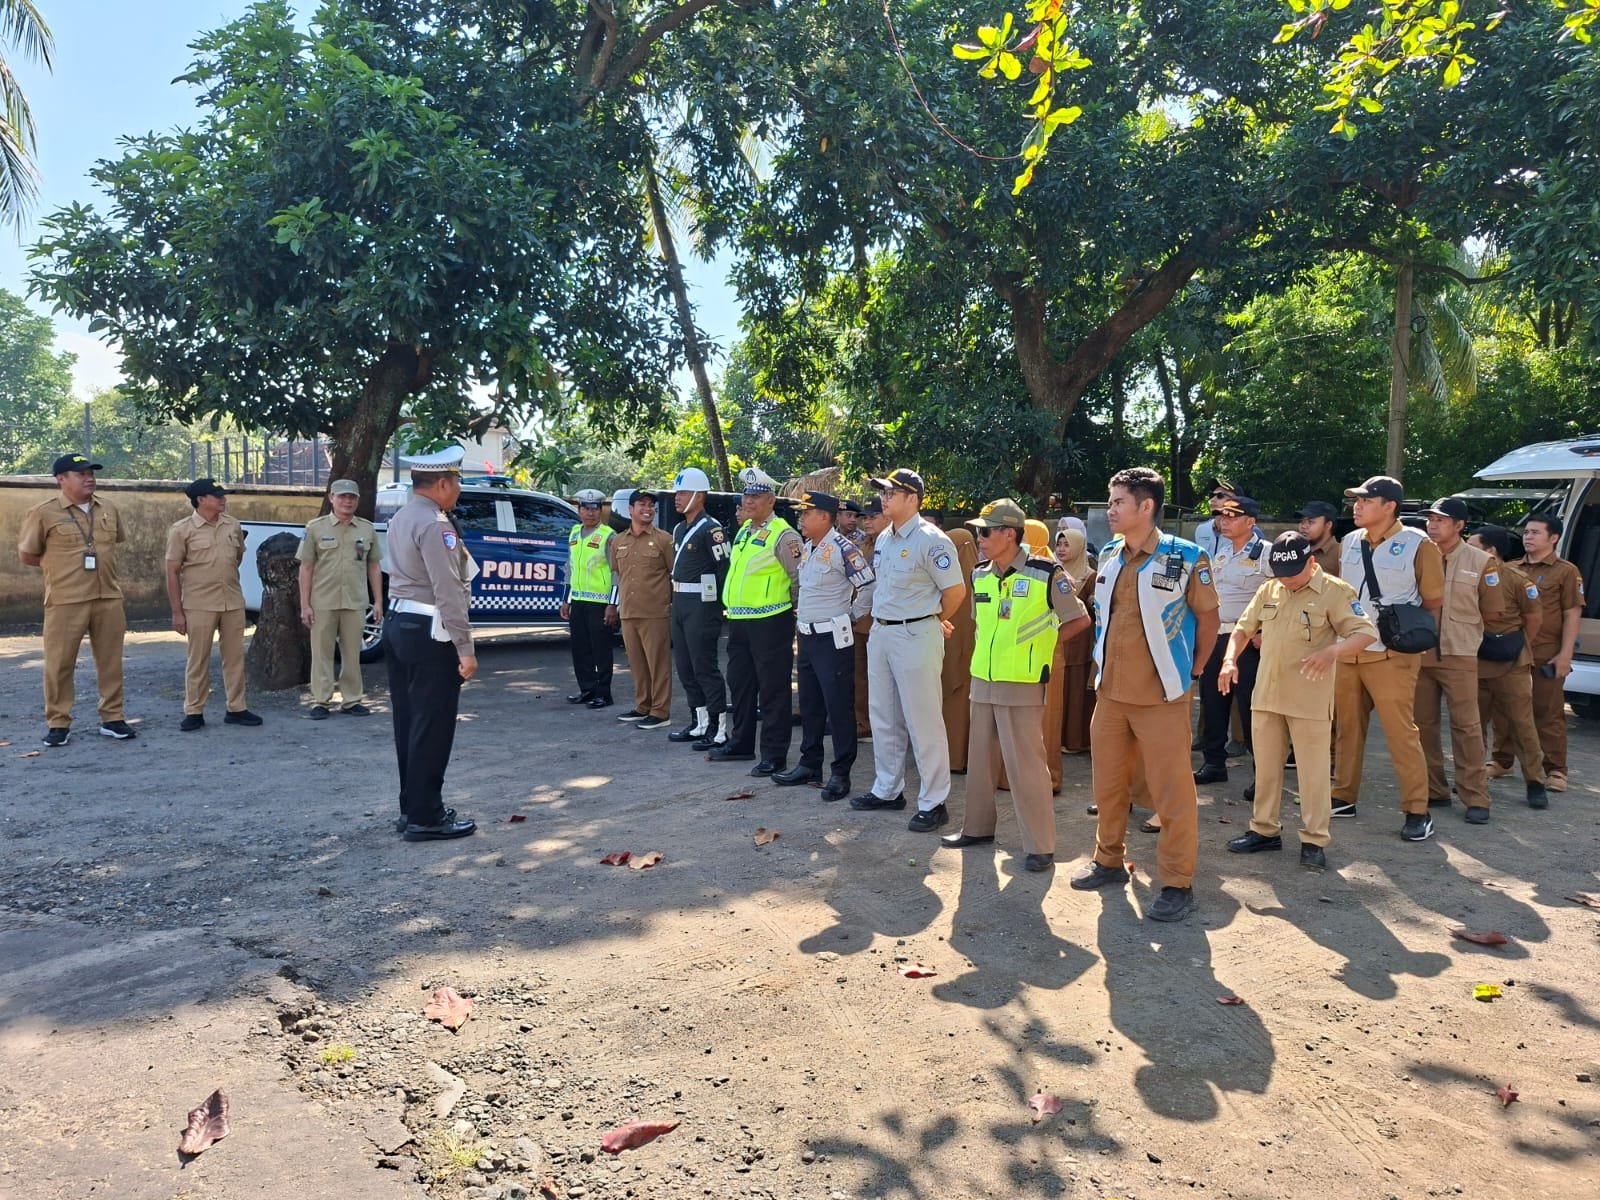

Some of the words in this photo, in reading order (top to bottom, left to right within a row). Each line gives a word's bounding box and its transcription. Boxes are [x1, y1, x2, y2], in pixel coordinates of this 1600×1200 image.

[482, 560, 556, 580] POLISI
[481, 583, 512, 591] LALU
[513, 584, 555, 592] LINTAS
